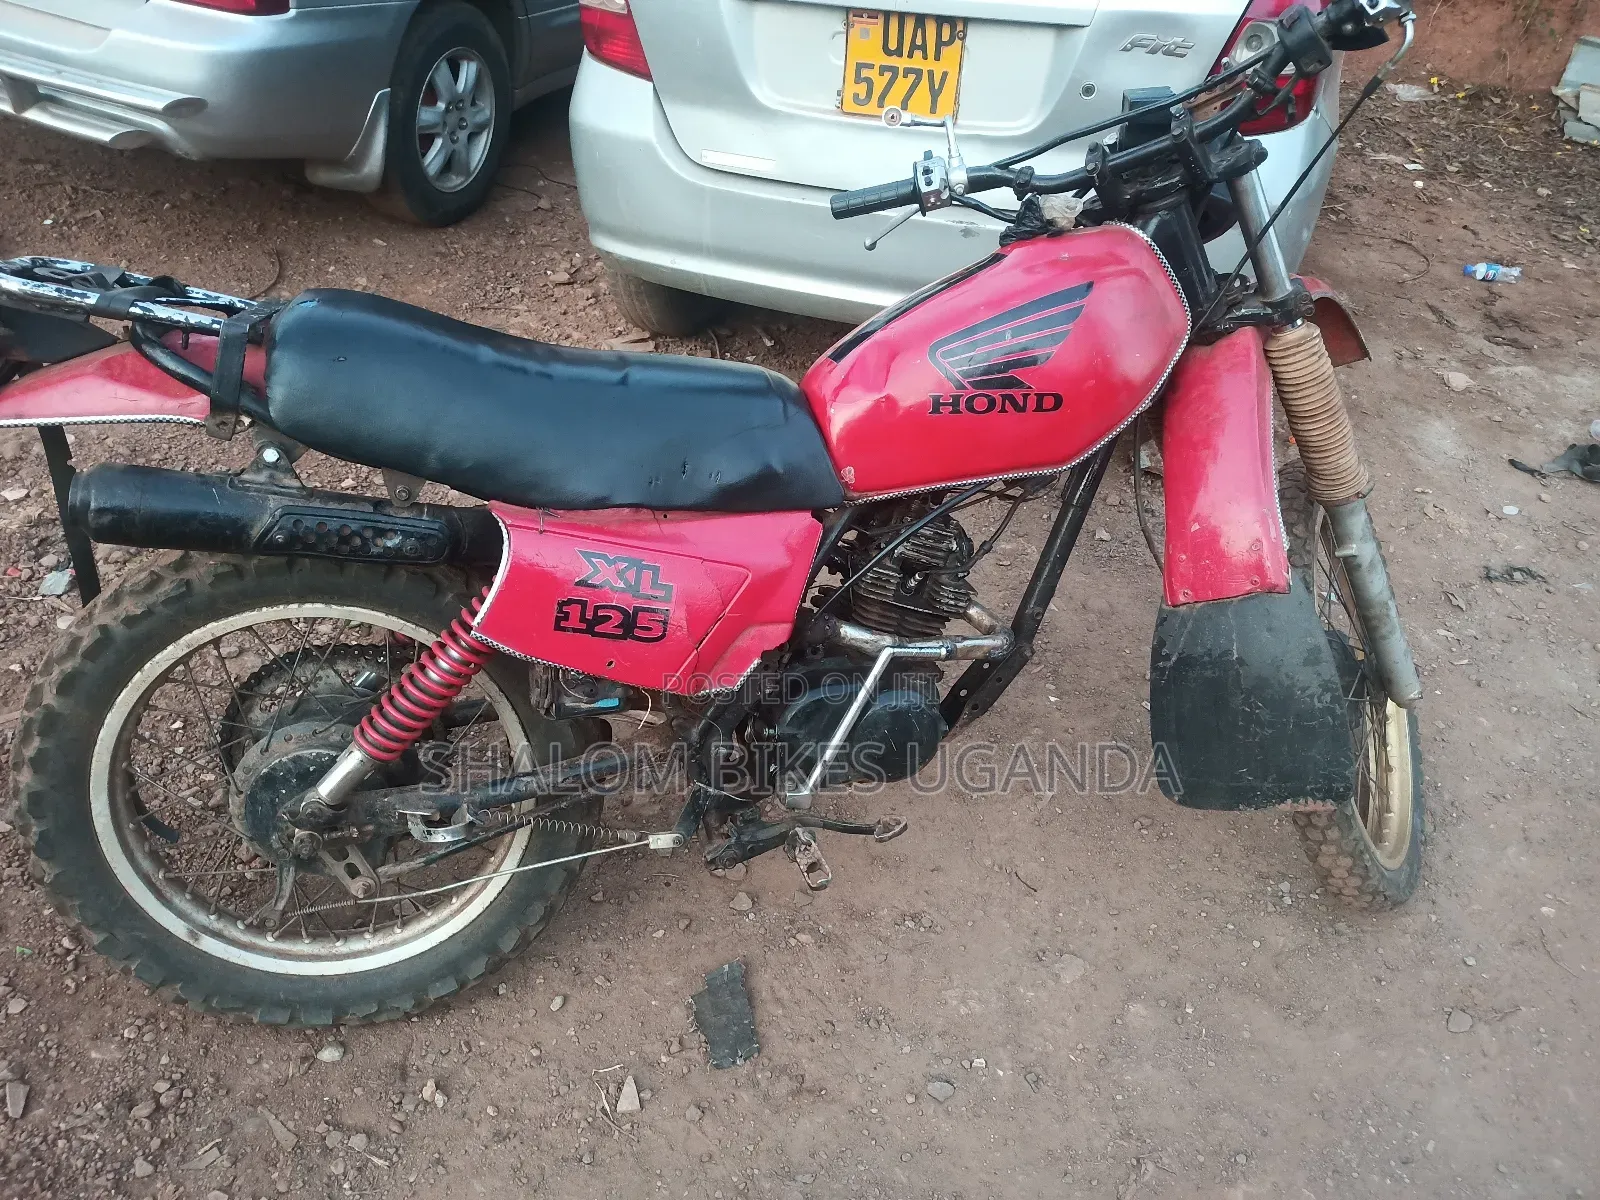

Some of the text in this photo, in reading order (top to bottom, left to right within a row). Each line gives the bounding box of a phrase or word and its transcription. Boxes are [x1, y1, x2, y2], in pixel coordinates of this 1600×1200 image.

[882, 12, 958, 61] UAP
[852, 62, 949, 114] 577Y
[927, 391, 1064, 415] HOND
[574, 548, 674, 603] XL
[553, 597, 671, 643] 125
